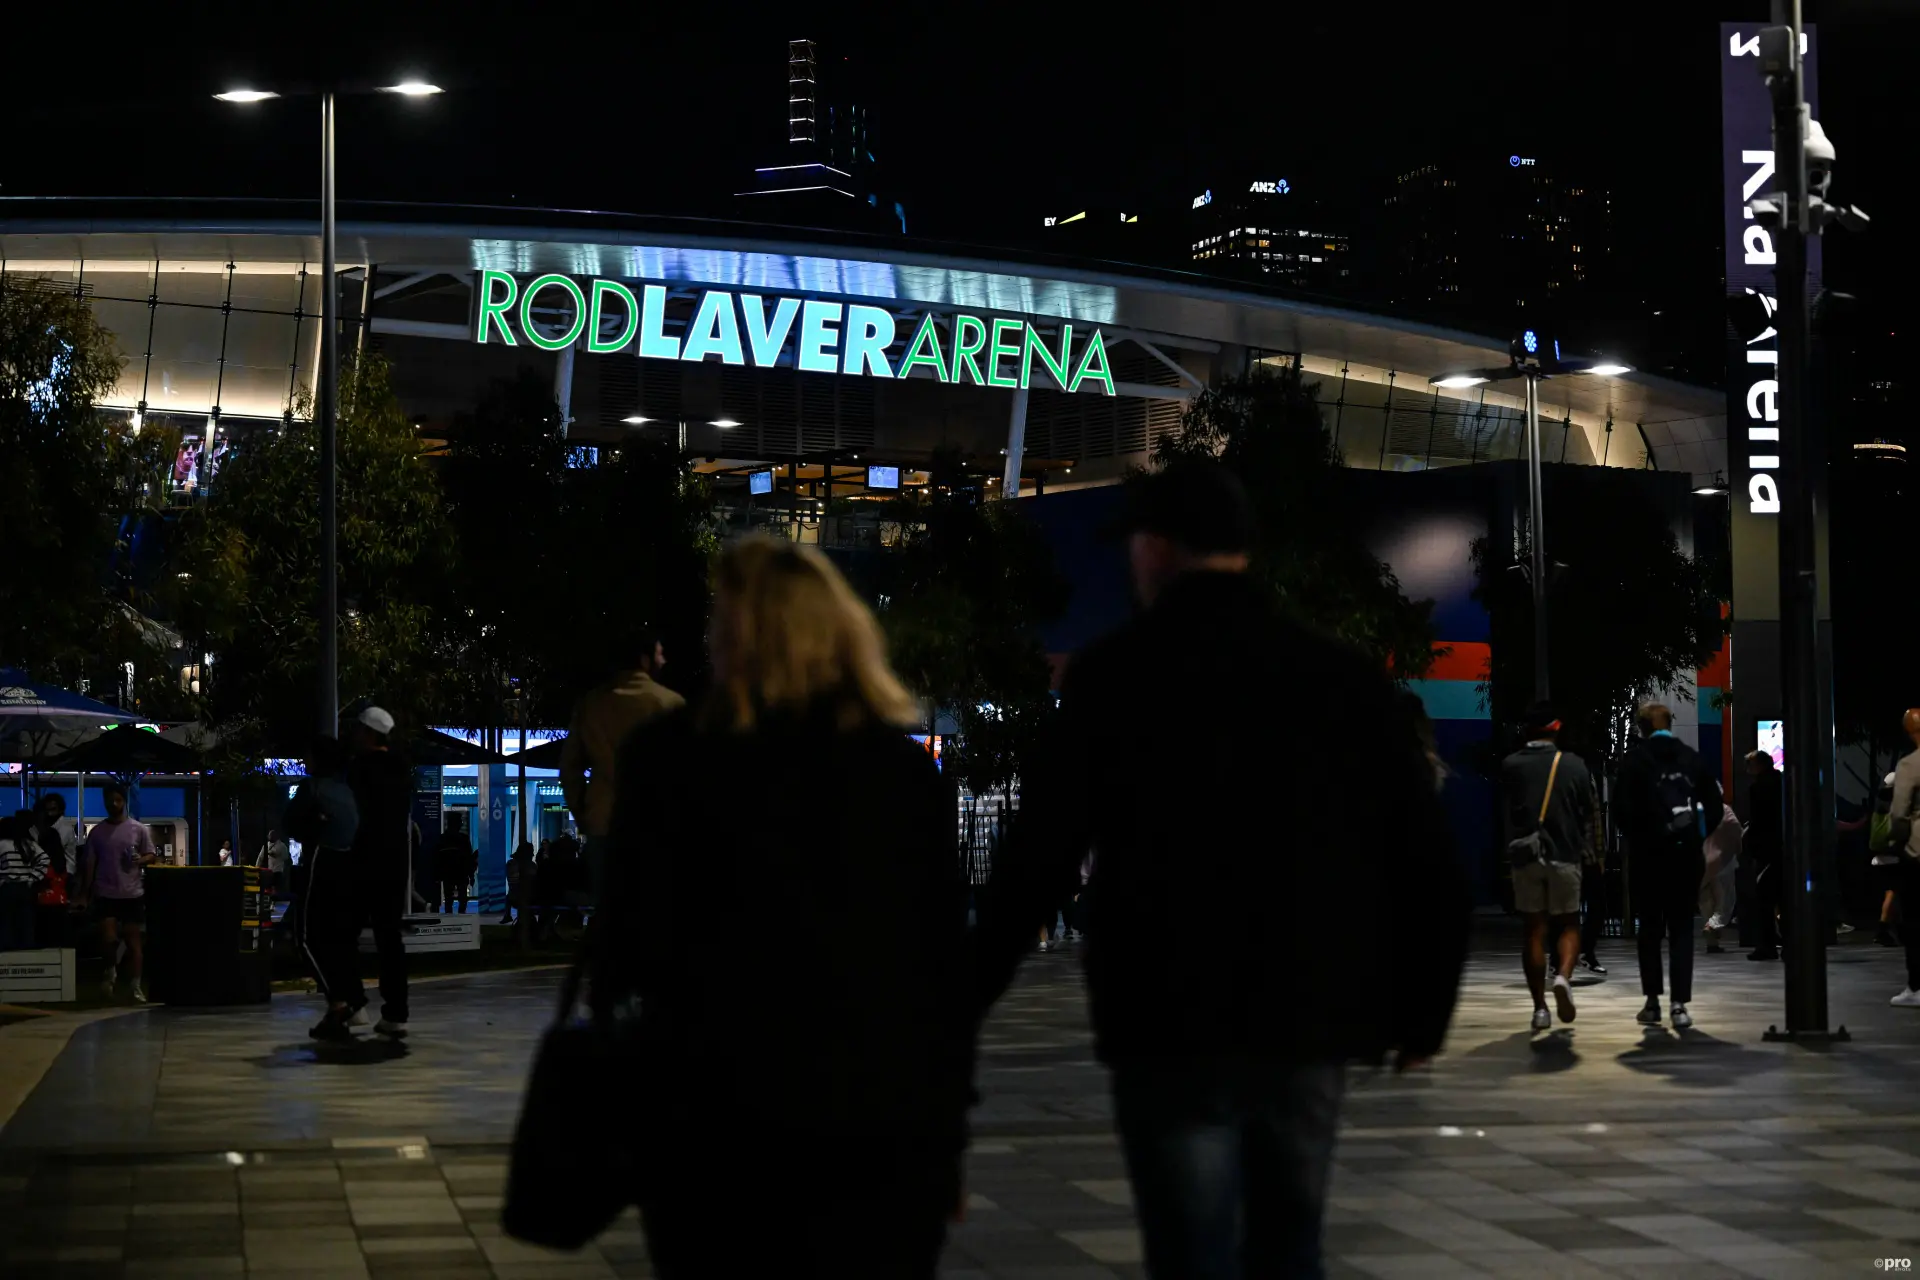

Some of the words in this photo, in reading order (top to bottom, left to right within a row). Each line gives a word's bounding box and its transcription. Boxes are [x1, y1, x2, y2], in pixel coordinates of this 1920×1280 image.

[1397, 163, 1438, 184] SOFITEL
[1249, 181, 1276, 194] ANZ
[1044, 216, 1057, 227] EY
[477, 269, 638, 354] ROD
[637, 284, 897, 379] LAVER
[896, 312, 1118, 397] ARENA
